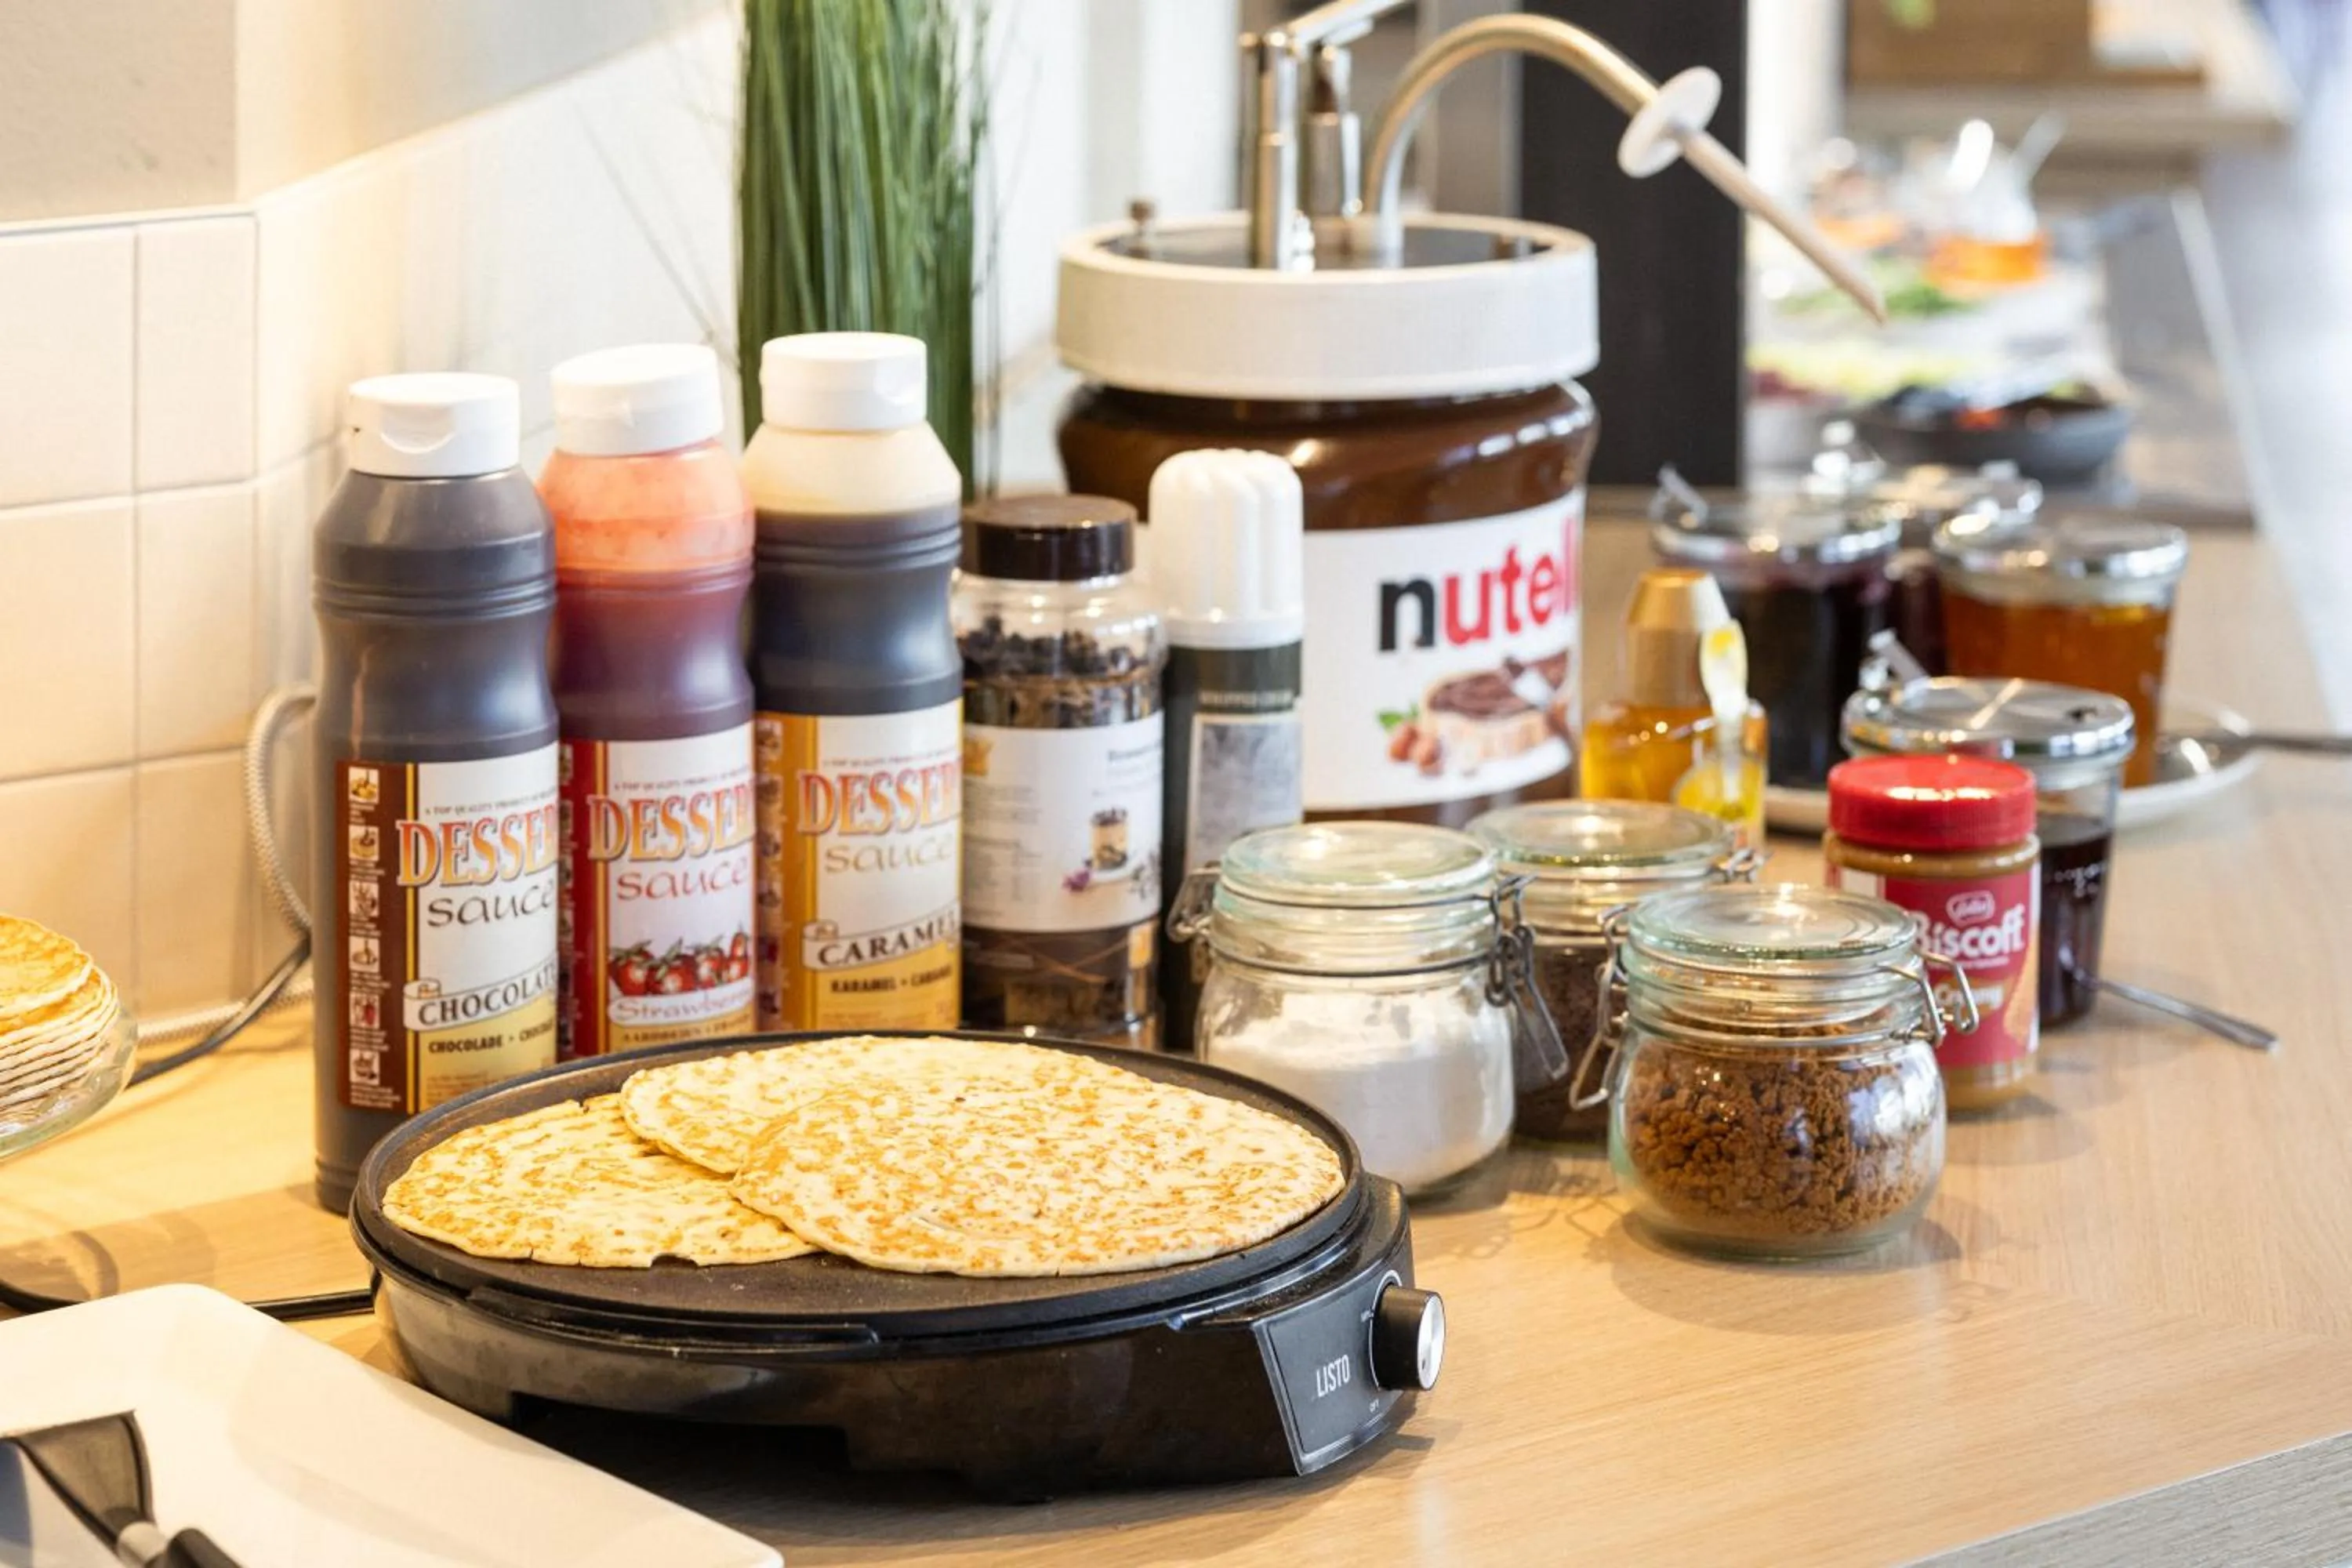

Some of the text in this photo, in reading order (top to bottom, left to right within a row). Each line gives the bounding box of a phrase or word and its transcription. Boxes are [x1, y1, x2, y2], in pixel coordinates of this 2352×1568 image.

[418, 962, 556, 1026] CHOCOLAT
[428, 1035, 503, 1054] CHOCOLADE
[1316, 1354, 1350, 1397] LISTO
